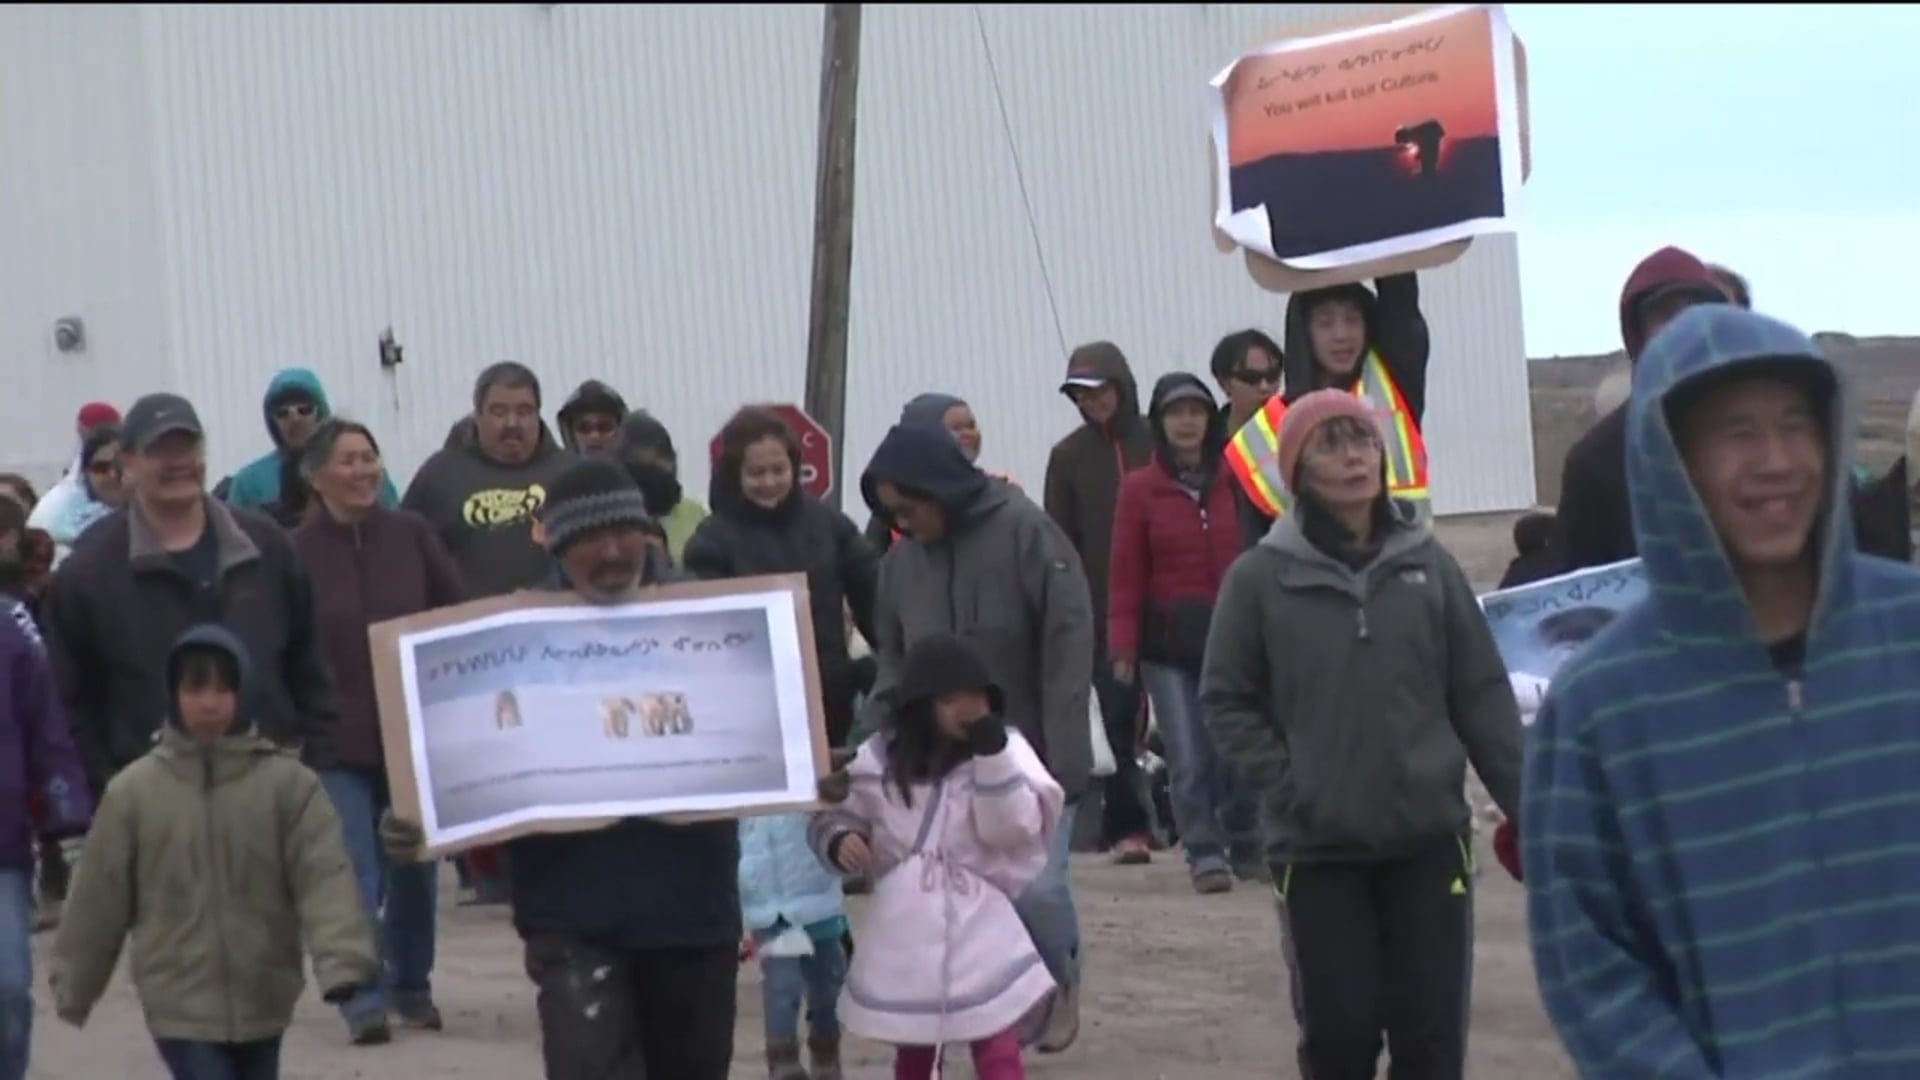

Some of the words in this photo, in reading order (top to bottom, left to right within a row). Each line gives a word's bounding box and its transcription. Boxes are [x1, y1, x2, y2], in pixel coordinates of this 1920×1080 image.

[1263, 102, 1293, 118] You
[1297, 93, 1321, 110] will
[1325, 88, 1347, 103] kill
[1351, 83, 1376, 99] our
